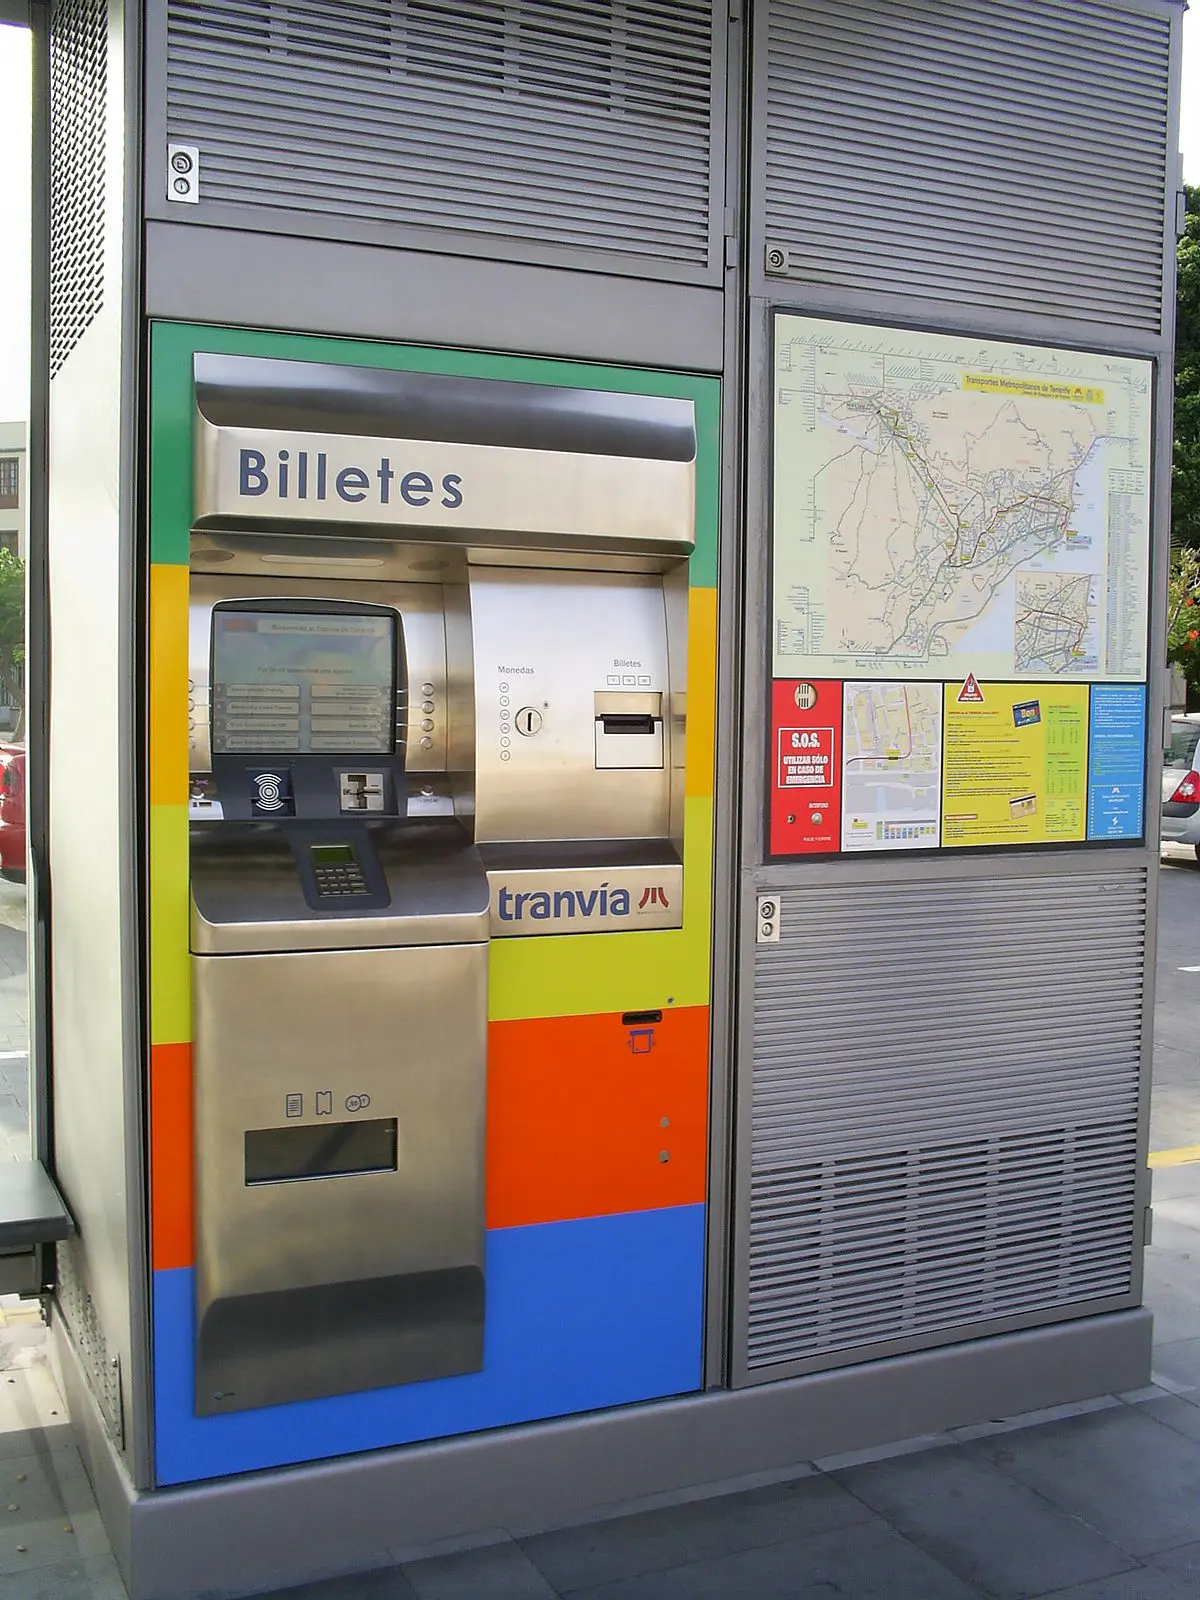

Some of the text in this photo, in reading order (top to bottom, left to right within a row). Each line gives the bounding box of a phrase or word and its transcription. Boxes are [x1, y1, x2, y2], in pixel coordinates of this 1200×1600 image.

[1049, 384, 1071, 394] Tenerife
[239, 448, 463, 509] Billetes
[613, 659, 642, 668] Billetes
[497, 665, 535, 675] Monedas
[791, 732, 820, 748] S.O.S.
[783, 753, 829, 765] UTILIZAR SÓLO
[787, 765, 824, 775] EN CASO DE
[498, 881, 630, 921] tranvía
